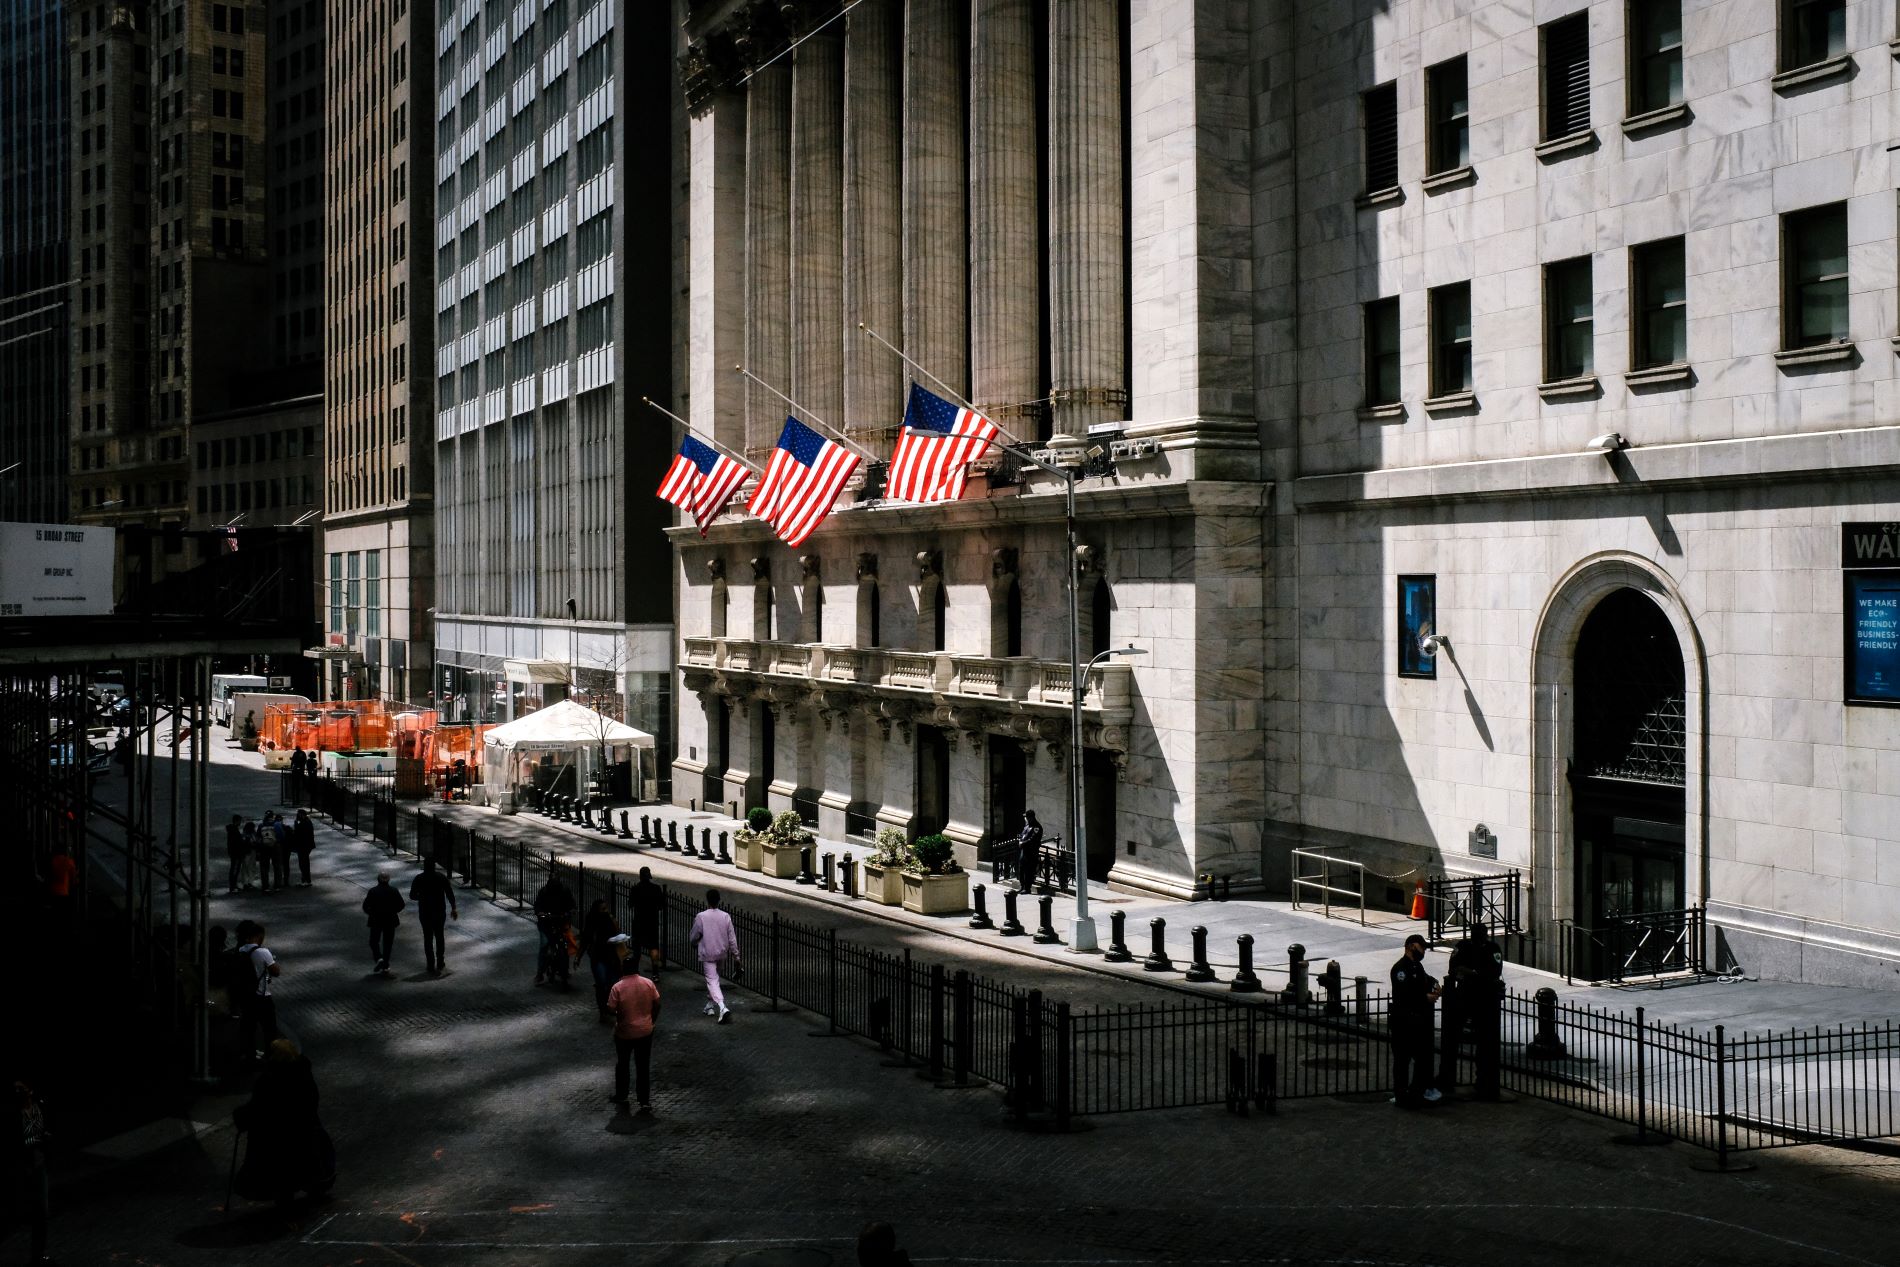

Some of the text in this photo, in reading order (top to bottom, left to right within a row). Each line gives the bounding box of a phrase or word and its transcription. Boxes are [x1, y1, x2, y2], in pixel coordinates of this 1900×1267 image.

[36, 530, 84, 542] 15 BROAD STREET
[1859, 599, 1897, 607] WE MAKE
[1859, 620, 1897, 628] FRIENDLY
[1857, 631, 1900, 639] BUSINESS-
[1859, 641, 1897, 649] FRIENDLY
